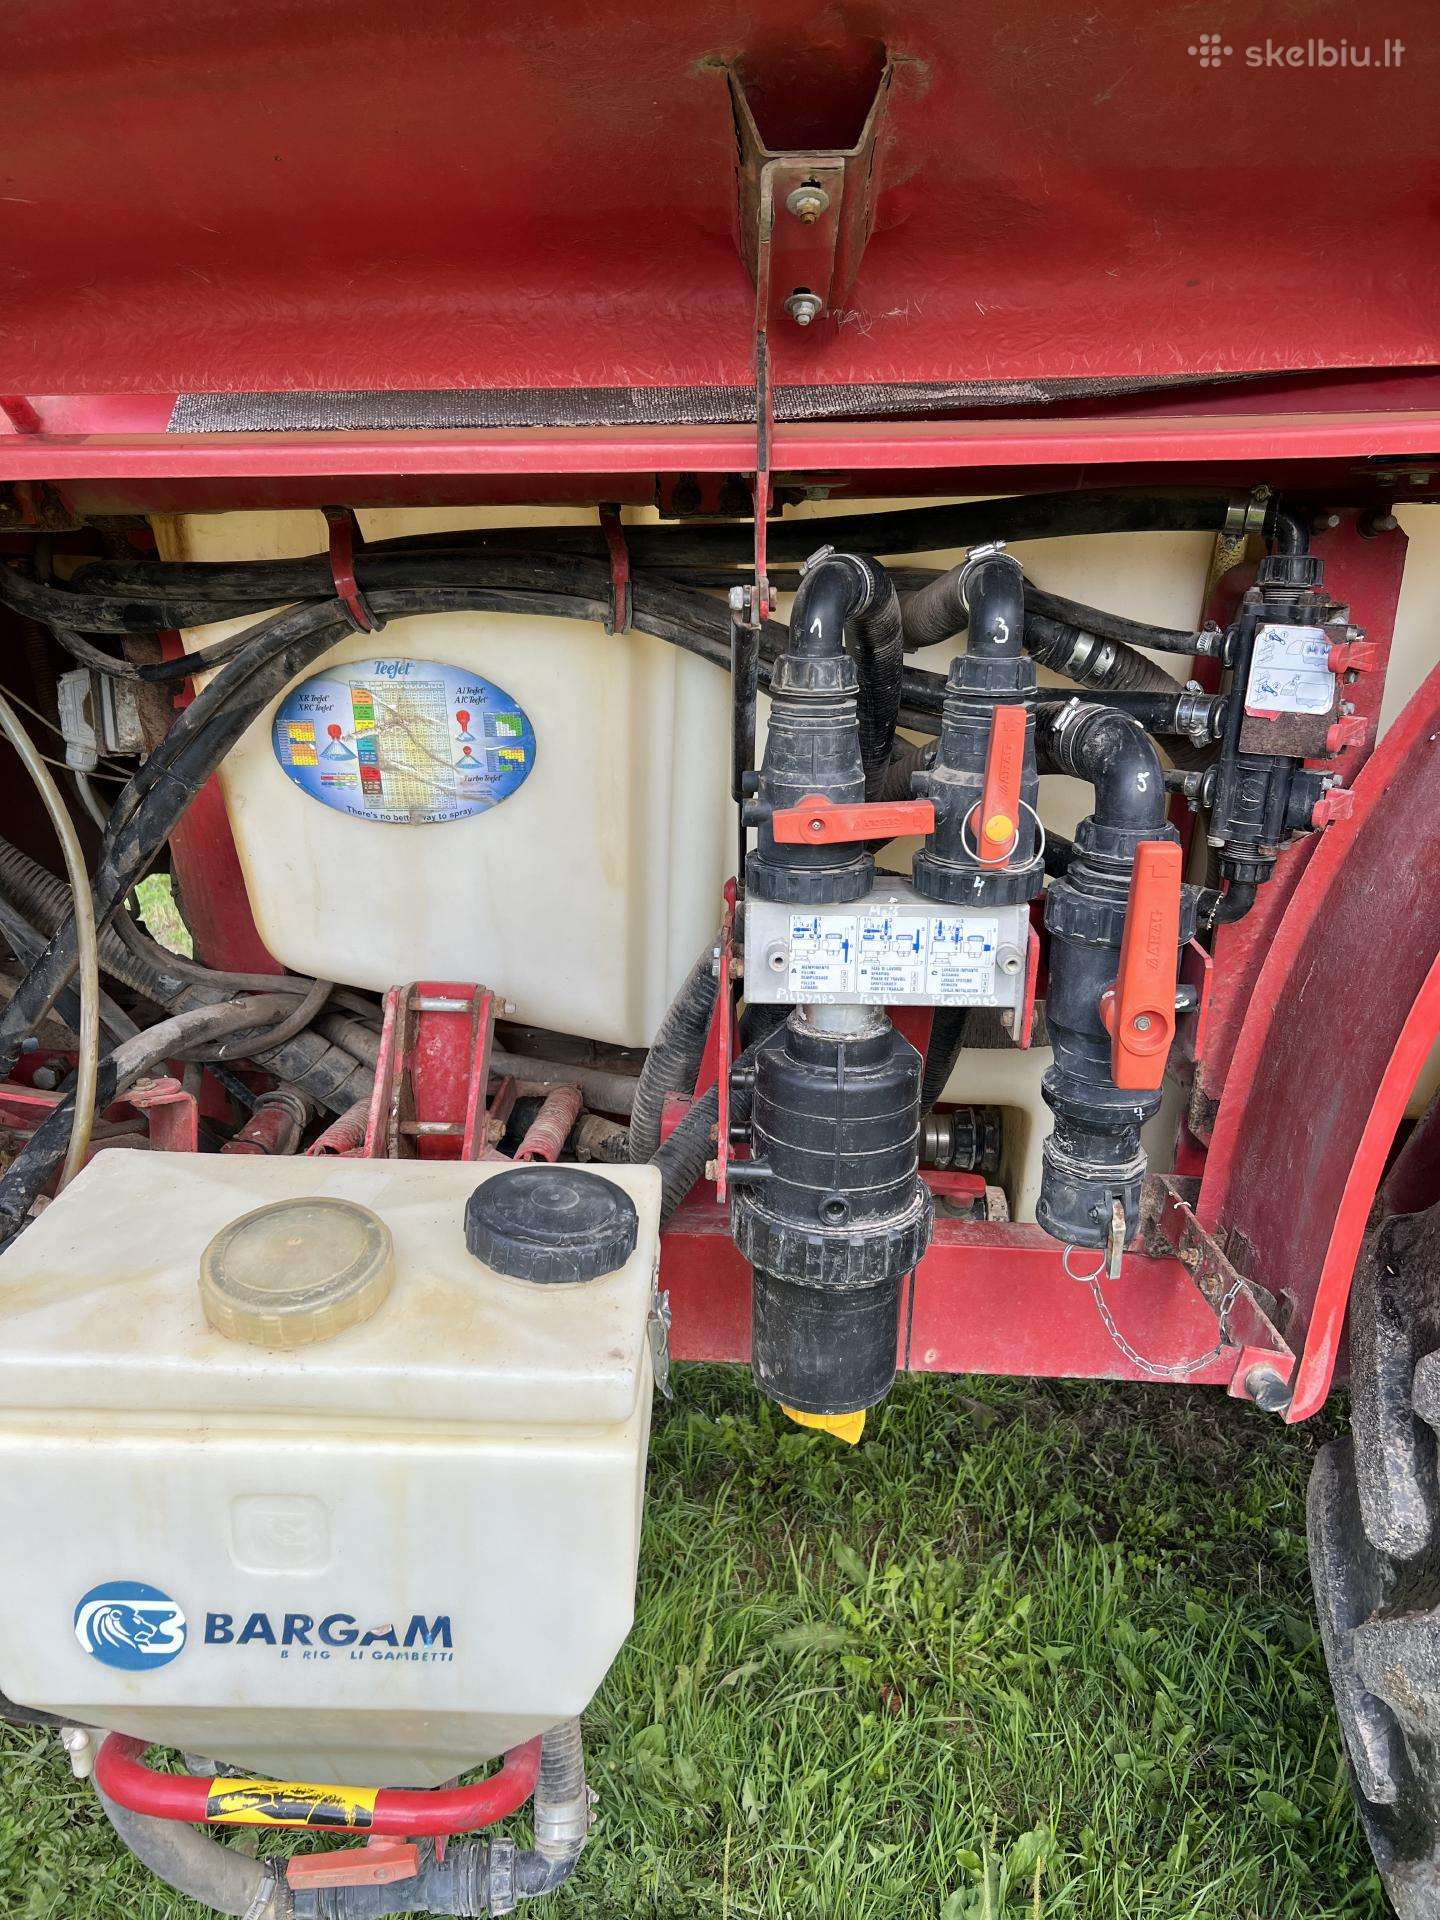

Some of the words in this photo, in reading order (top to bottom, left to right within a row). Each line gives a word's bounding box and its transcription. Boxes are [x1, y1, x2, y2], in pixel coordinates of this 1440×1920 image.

[810, 616, 822, 639] 1
[992, 617, 1009, 644] 3
[374, 660, 411, 679] TeeJet
[346, 805, 378, 819] There's
[204, 1612, 453, 1648] BARGAM
